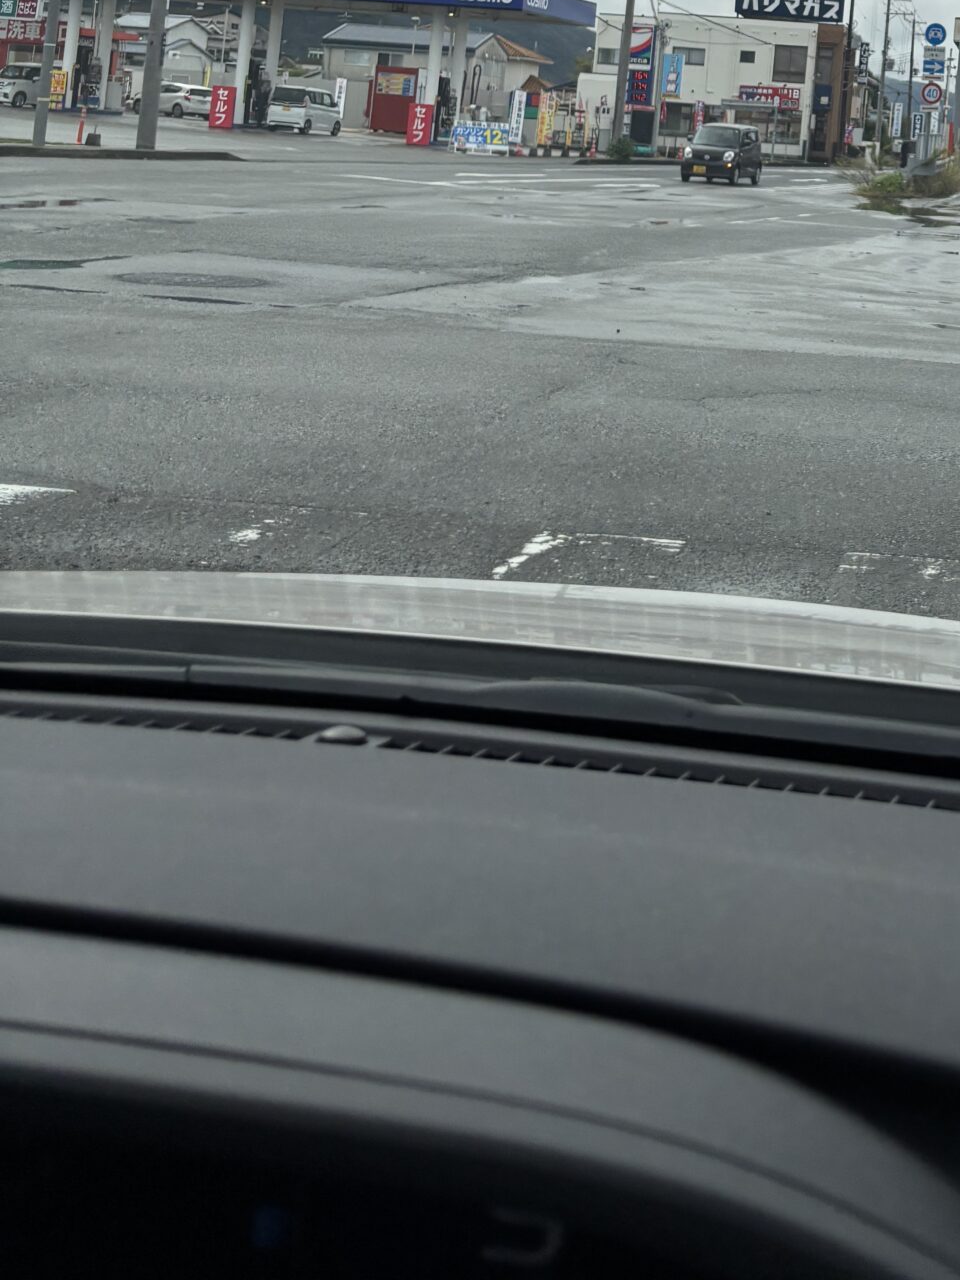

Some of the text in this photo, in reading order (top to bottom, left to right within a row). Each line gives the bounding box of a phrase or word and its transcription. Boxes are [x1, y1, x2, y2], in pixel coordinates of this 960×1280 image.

[1, 0, 14, 14] 酒
[17, 1, 37, 15] たばこ
[926, 88, 939, 99] 40
[215, 87, 229, 125] セルフ
[413, 105, 426, 142] セルフ
